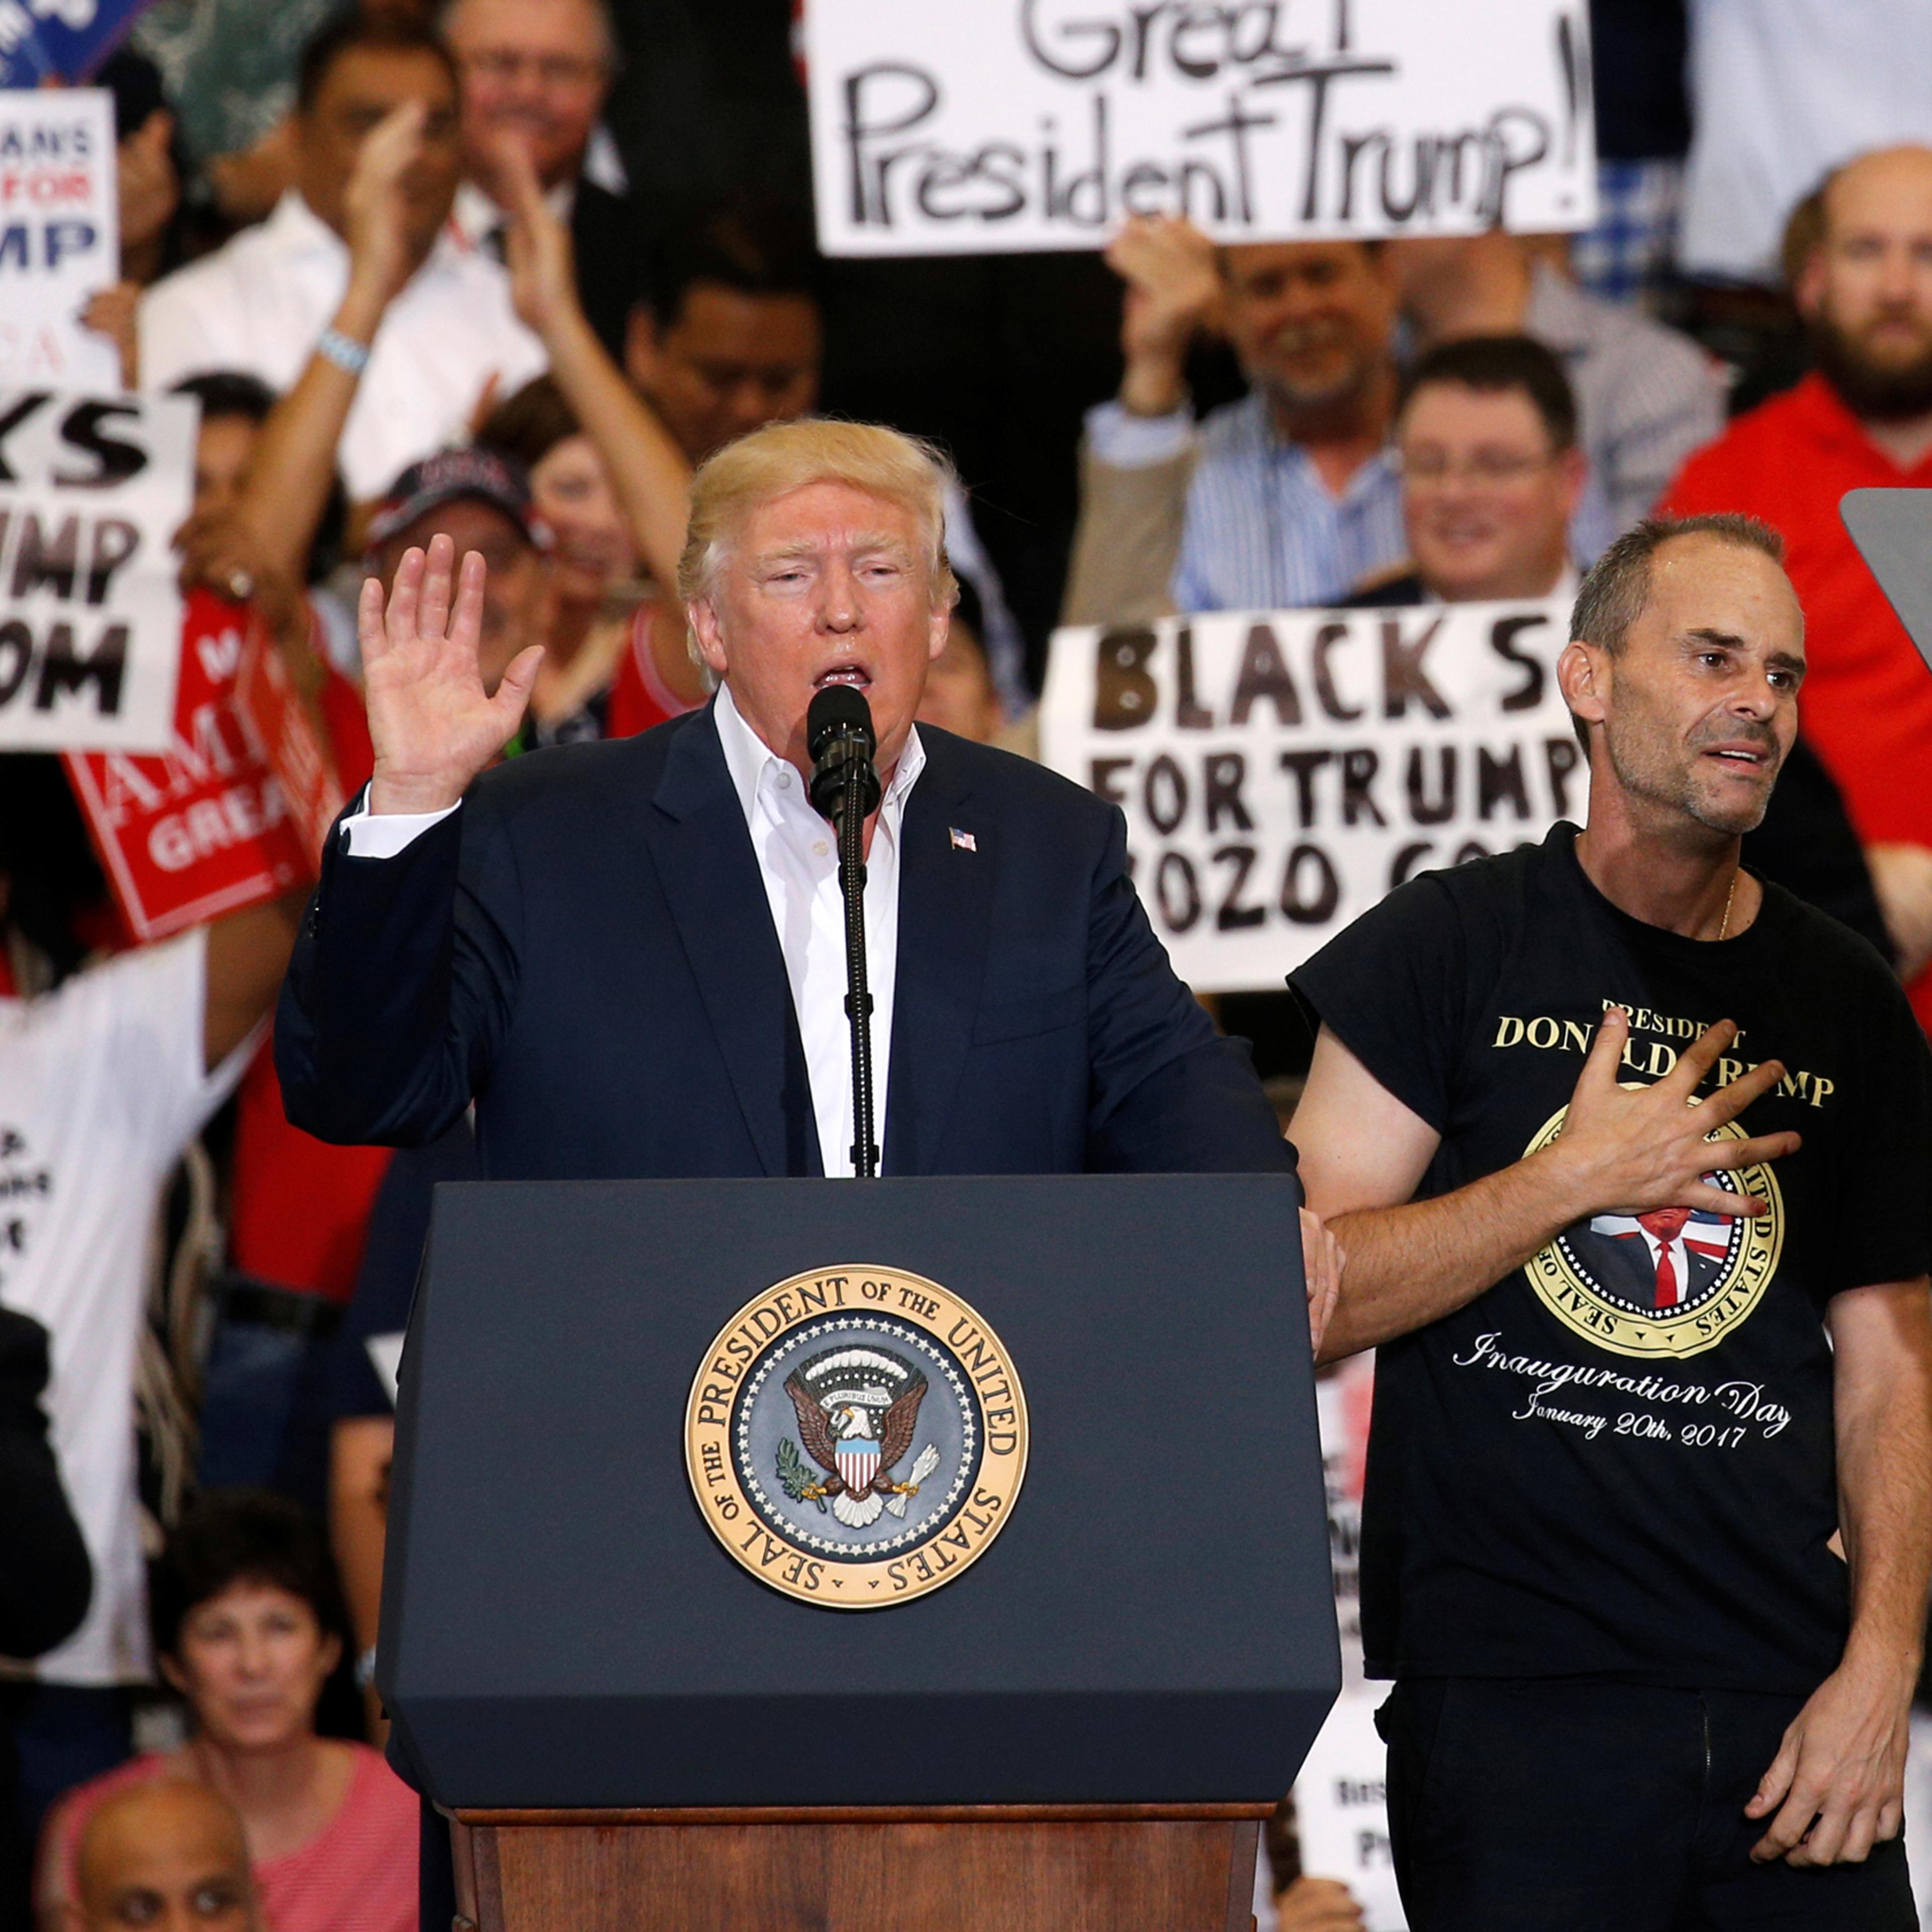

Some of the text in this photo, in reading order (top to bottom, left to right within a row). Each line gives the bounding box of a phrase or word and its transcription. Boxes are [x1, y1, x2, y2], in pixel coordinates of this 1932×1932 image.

[1, 172, 92, 205] FOR
[845, 61, 1275, 226] President
[0, 508, 140, 605] MP
[1088, 737, 1585, 836] FOR TRUMP
[1127, 842, 1341, 934] 020
[1491, 1015, 1835, 1108] DONLD RMP
[1556, 1279, 1619, 1336] SEAL
[1696, 1247, 1768, 1337] STATES
[1452, 1331, 1793, 1439] Inauguration Day
[1511, 1392, 1748, 1449] January 20th, 2017
[698, 1276, 1018, 1591] SEAL OF THE PRESIDENT OF THE UNITED STATES
